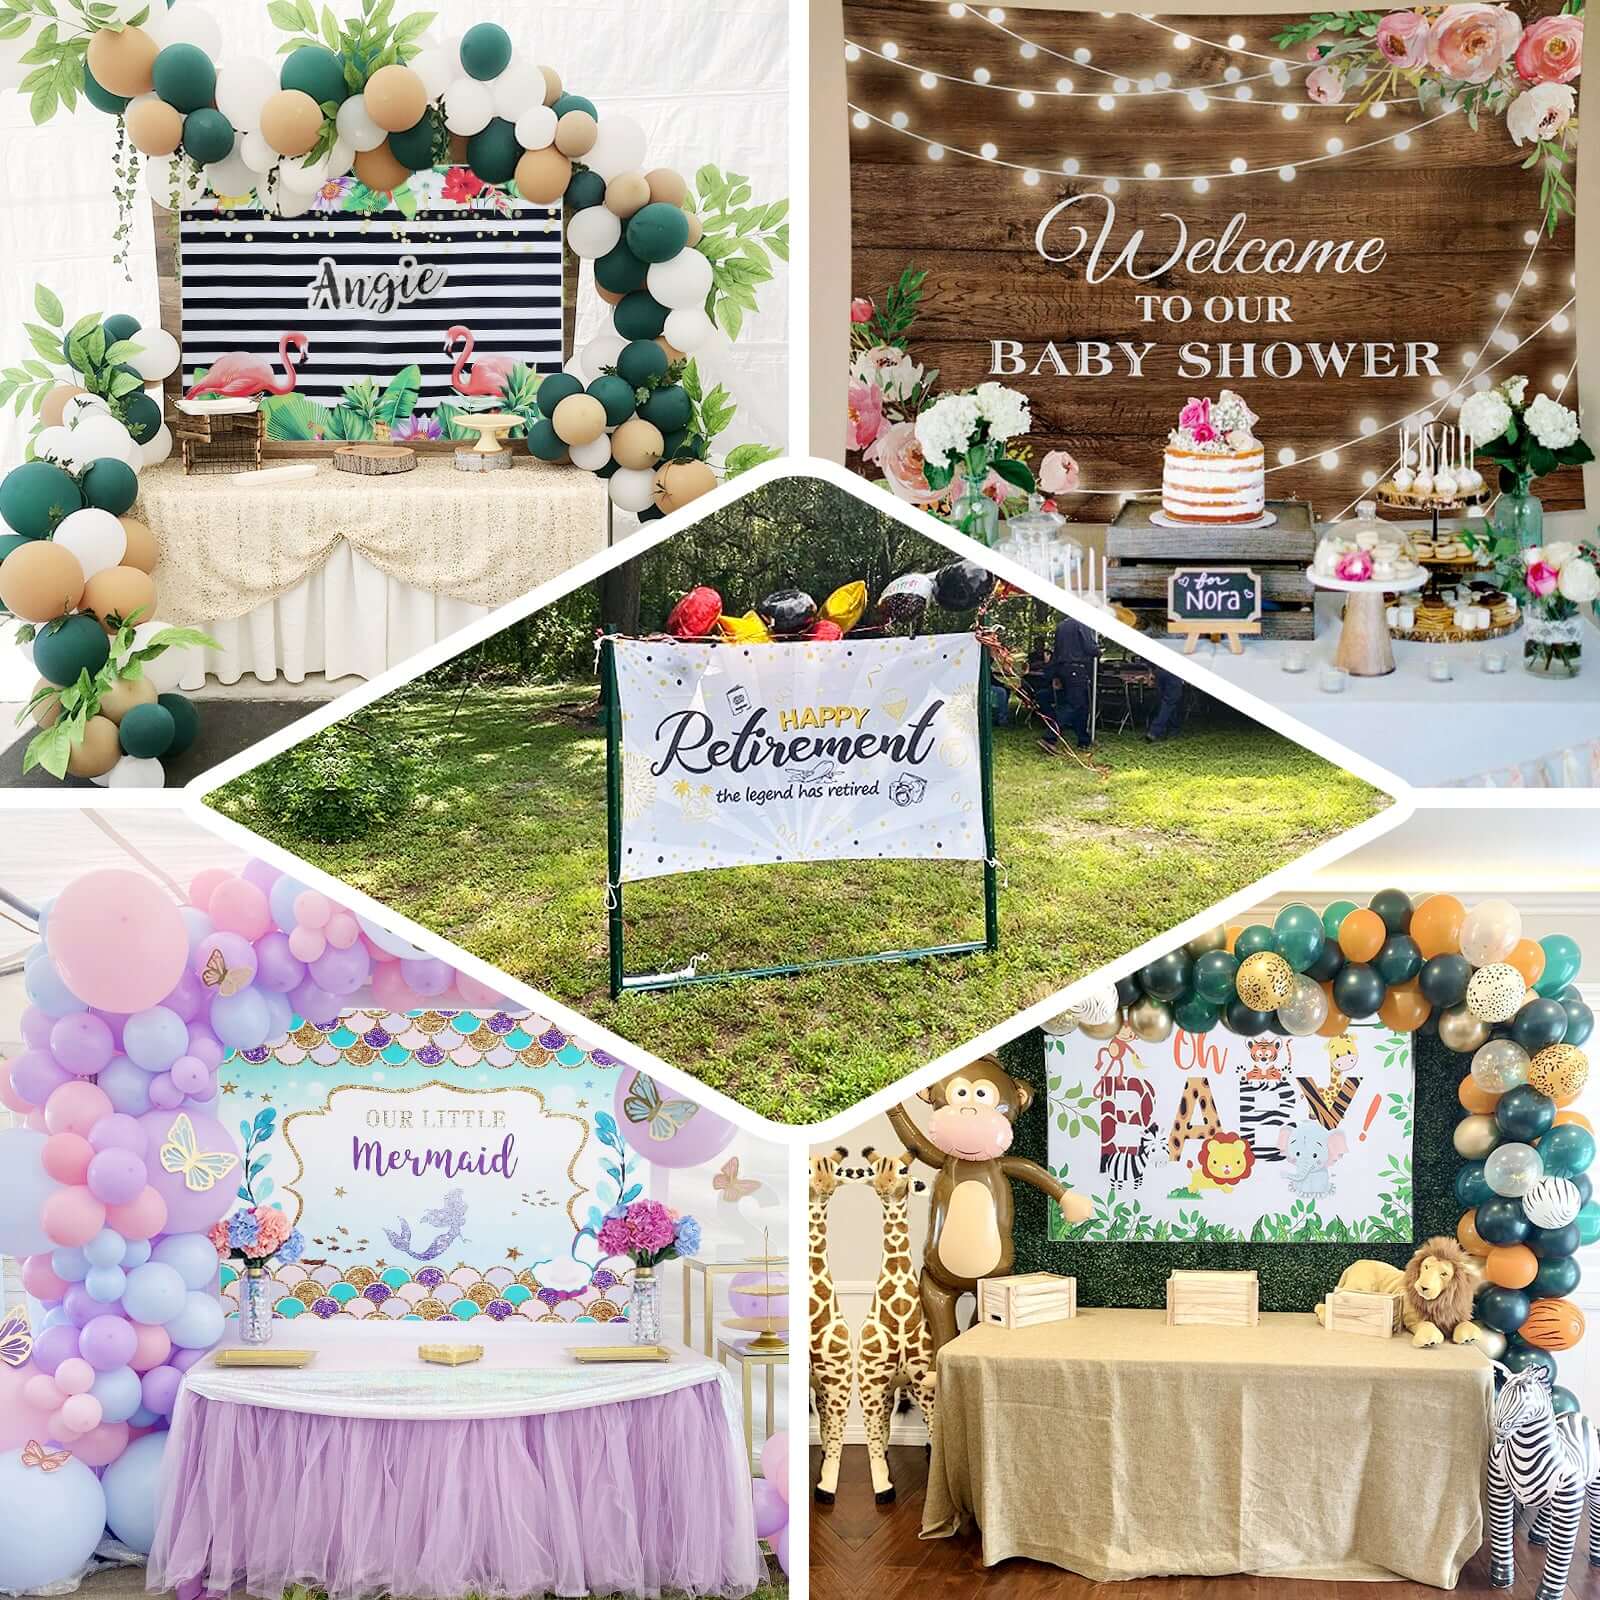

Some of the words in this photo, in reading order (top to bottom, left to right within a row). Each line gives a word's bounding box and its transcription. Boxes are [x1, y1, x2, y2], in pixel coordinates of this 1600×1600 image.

[1035, 193, 1387, 284] Welcome
[312, 259, 444, 314] Angie
[1135, 295, 1193, 324] TO
[1203, 295, 1293, 324] OUR
[988, 339, 1157, 377] BABY
[1177, 340, 1443, 379] SHOWER
[1194, 572, 1230, 590] for
[1186, 590, 1241, 612] Nora
[778, 706, 871, 733] HAPPY
[650, 699, 945, 777] Retirement
[716, 789, 741, 804] the
[745, 781, 793, 806] legend
[798, 783, 824, 799] has
[827, 780, 880, 797] retired
[1173, 1029, 1228, 1075] Oh
[365, 1108, 415, 1129] OUR
[421, 1108, 507, 1129] LITTLE
[352, 1132, 519, 1180] Mermaid
